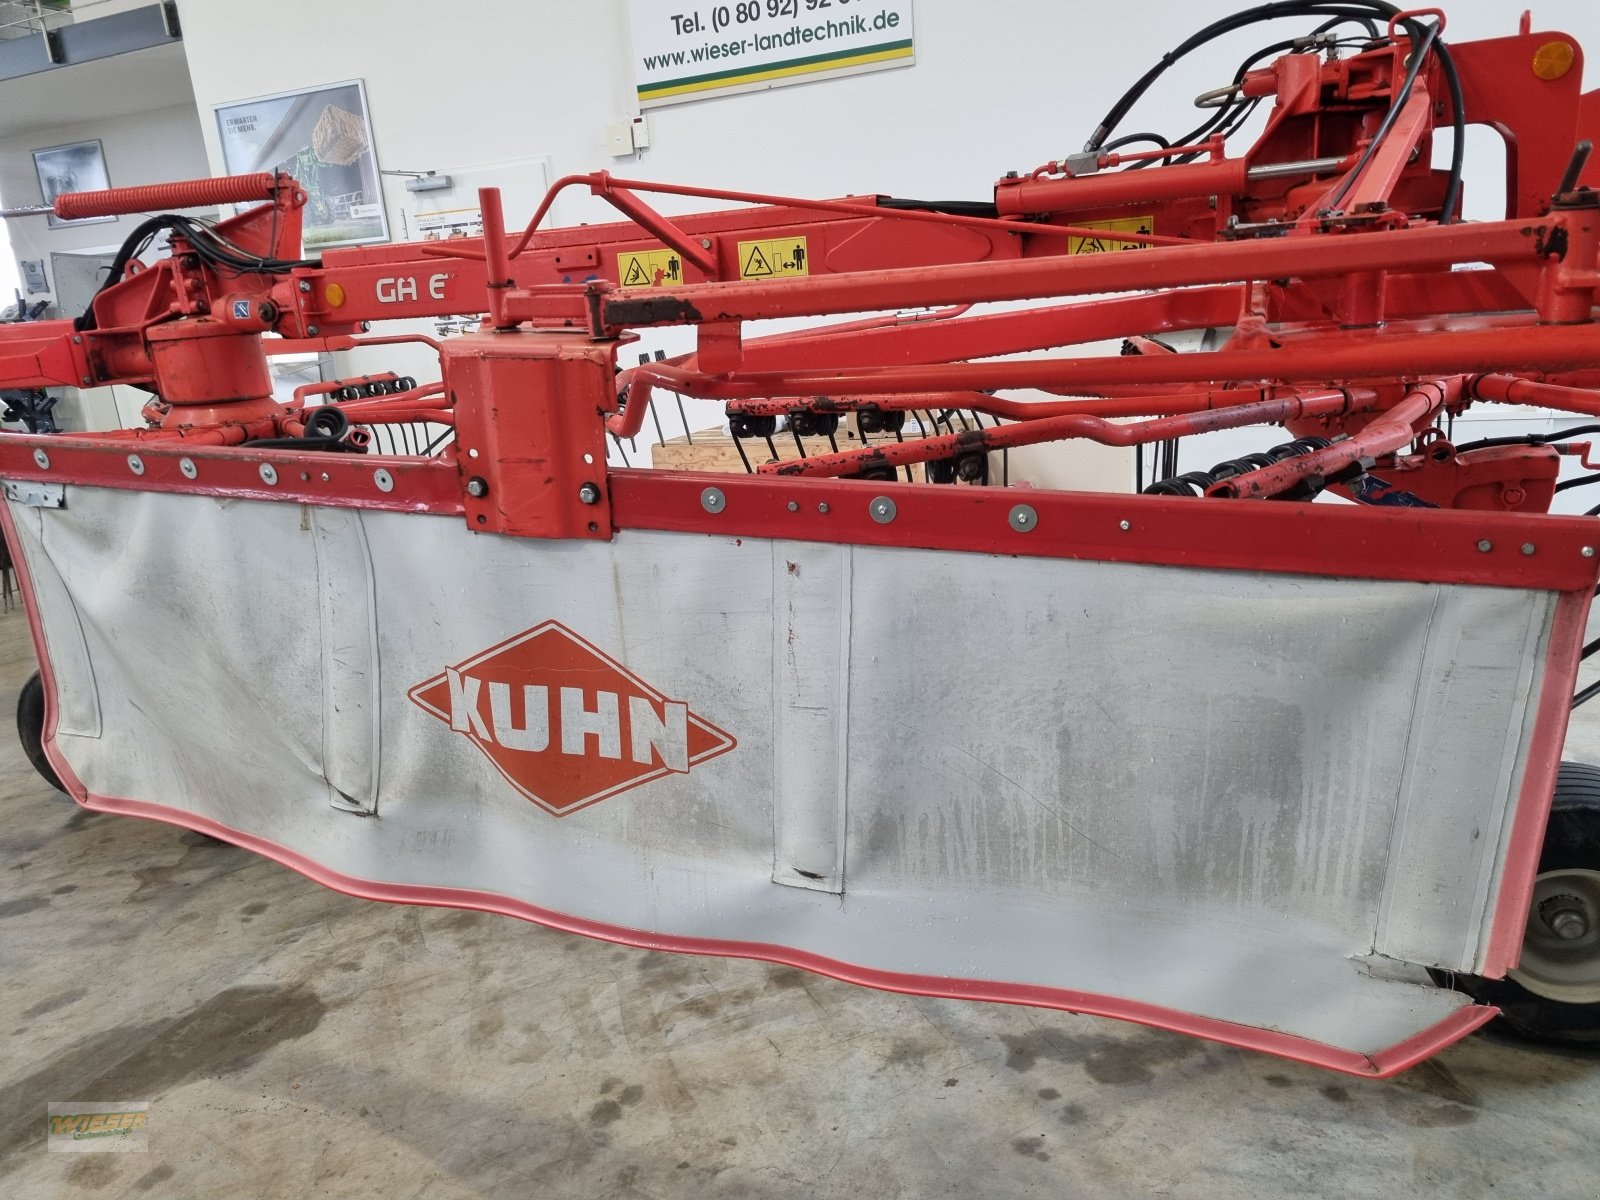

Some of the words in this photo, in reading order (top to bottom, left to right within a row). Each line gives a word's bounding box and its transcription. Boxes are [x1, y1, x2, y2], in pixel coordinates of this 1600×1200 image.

[670, 11, 706, 36] Tel.
[712, 6, 730, 33] (0
[735, 0, 761, 24] 80
[766, 0, 798, 19] 92)
[643, 9, 900, 71] www.wieser-landtechnik.de
[226, 115, 258, 127] ERWARTEN
[376, 276, 418, 303] GA
[445, 665, 689, 774] KUHN
